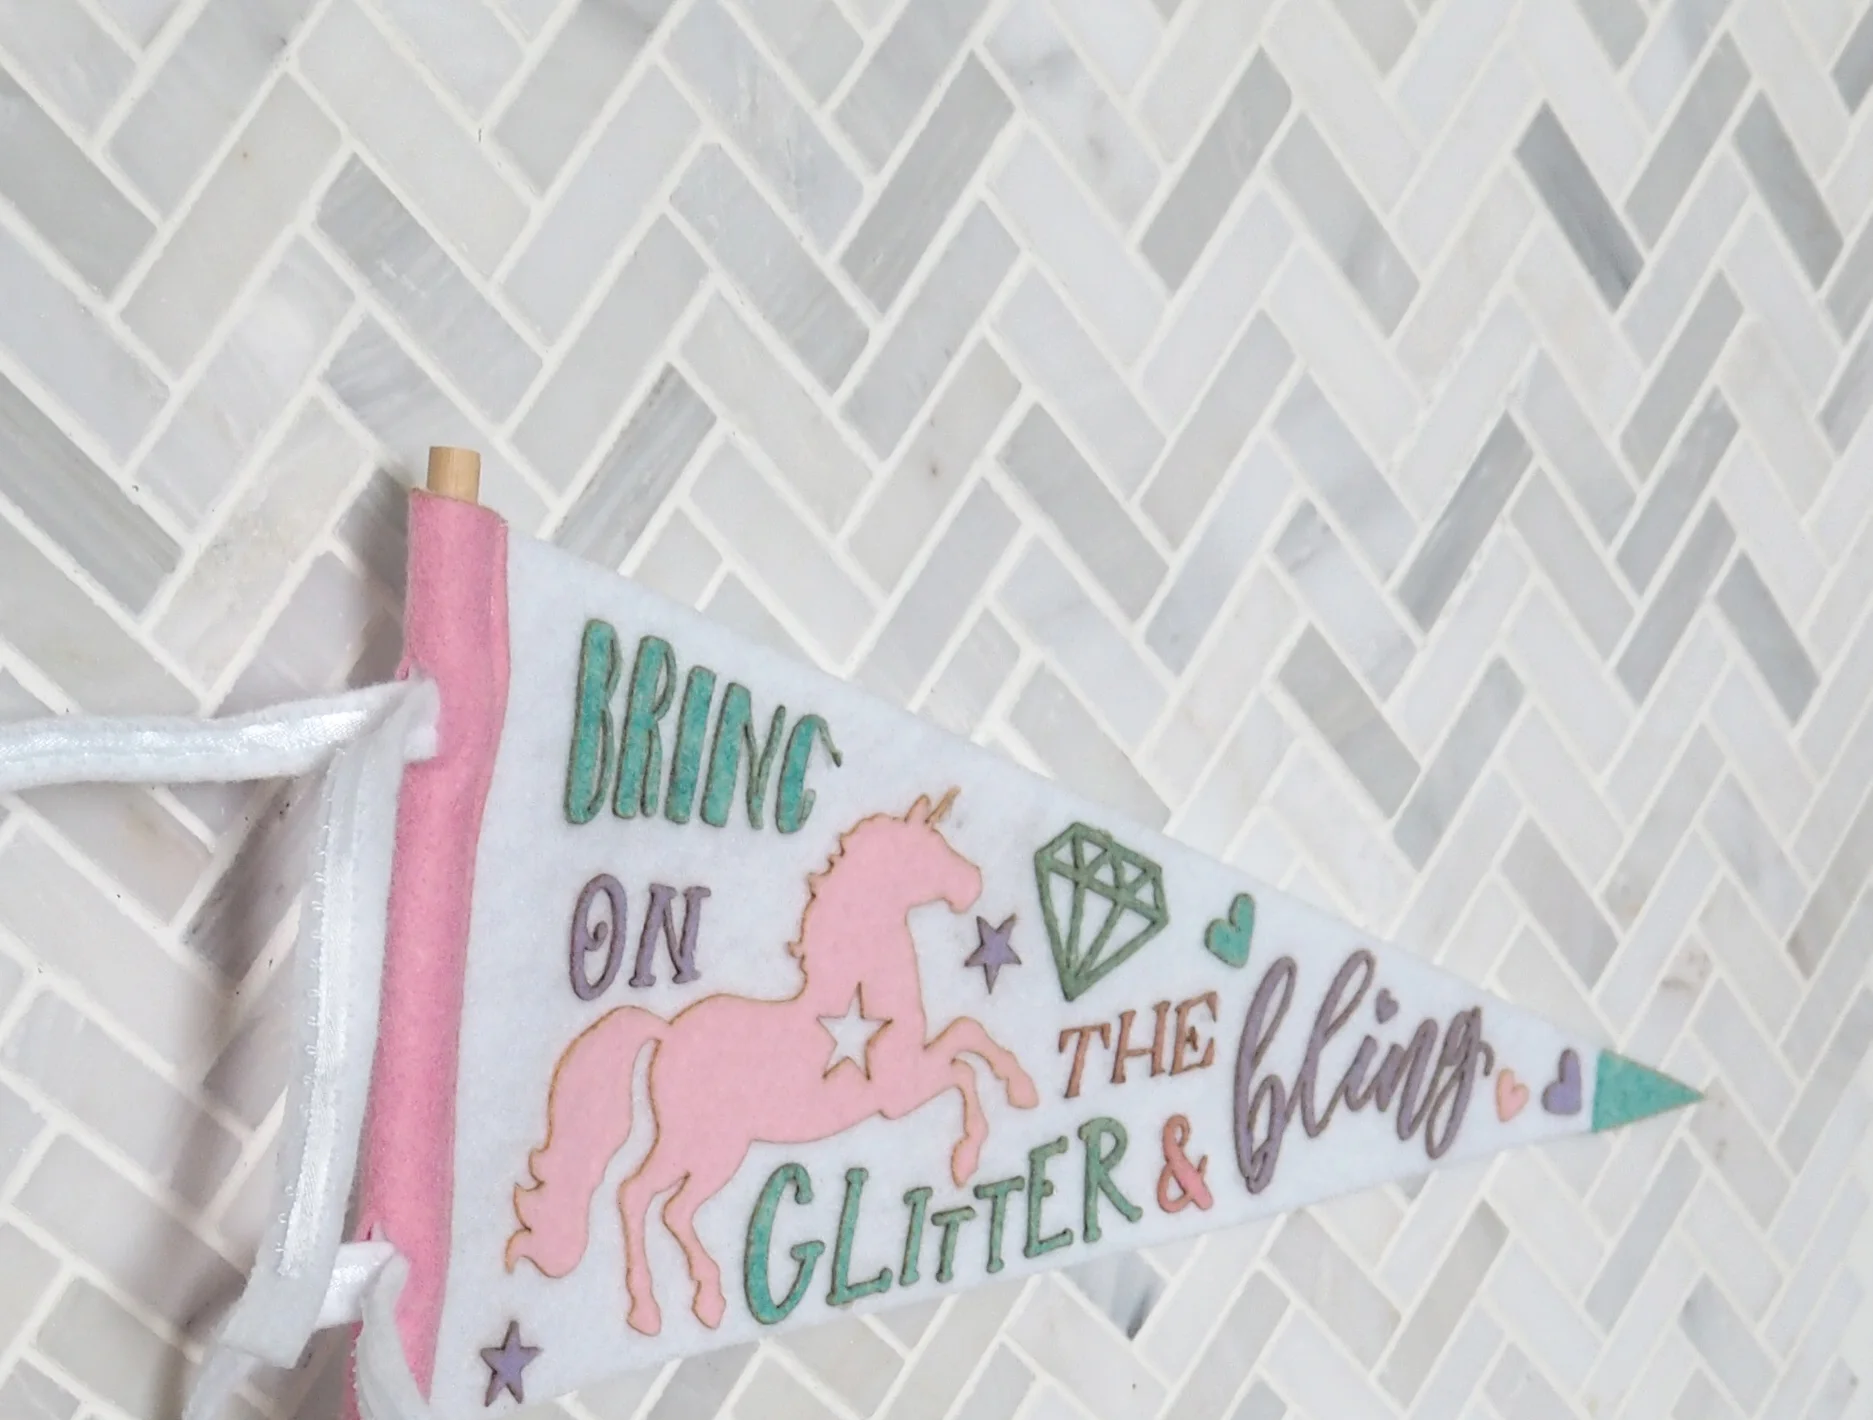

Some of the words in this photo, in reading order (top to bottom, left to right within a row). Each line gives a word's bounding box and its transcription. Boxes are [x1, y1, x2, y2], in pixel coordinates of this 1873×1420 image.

[563, 618, 842, 834] BRING
[569, 873, 711, 1001] ON
[1058, 991, 1219, 1099] THE
[743, 1116, 1143, 1324] GLITTER
[1157, 1114, 1213, 1213] &
[1233, 949, 1495, 1194] bling
